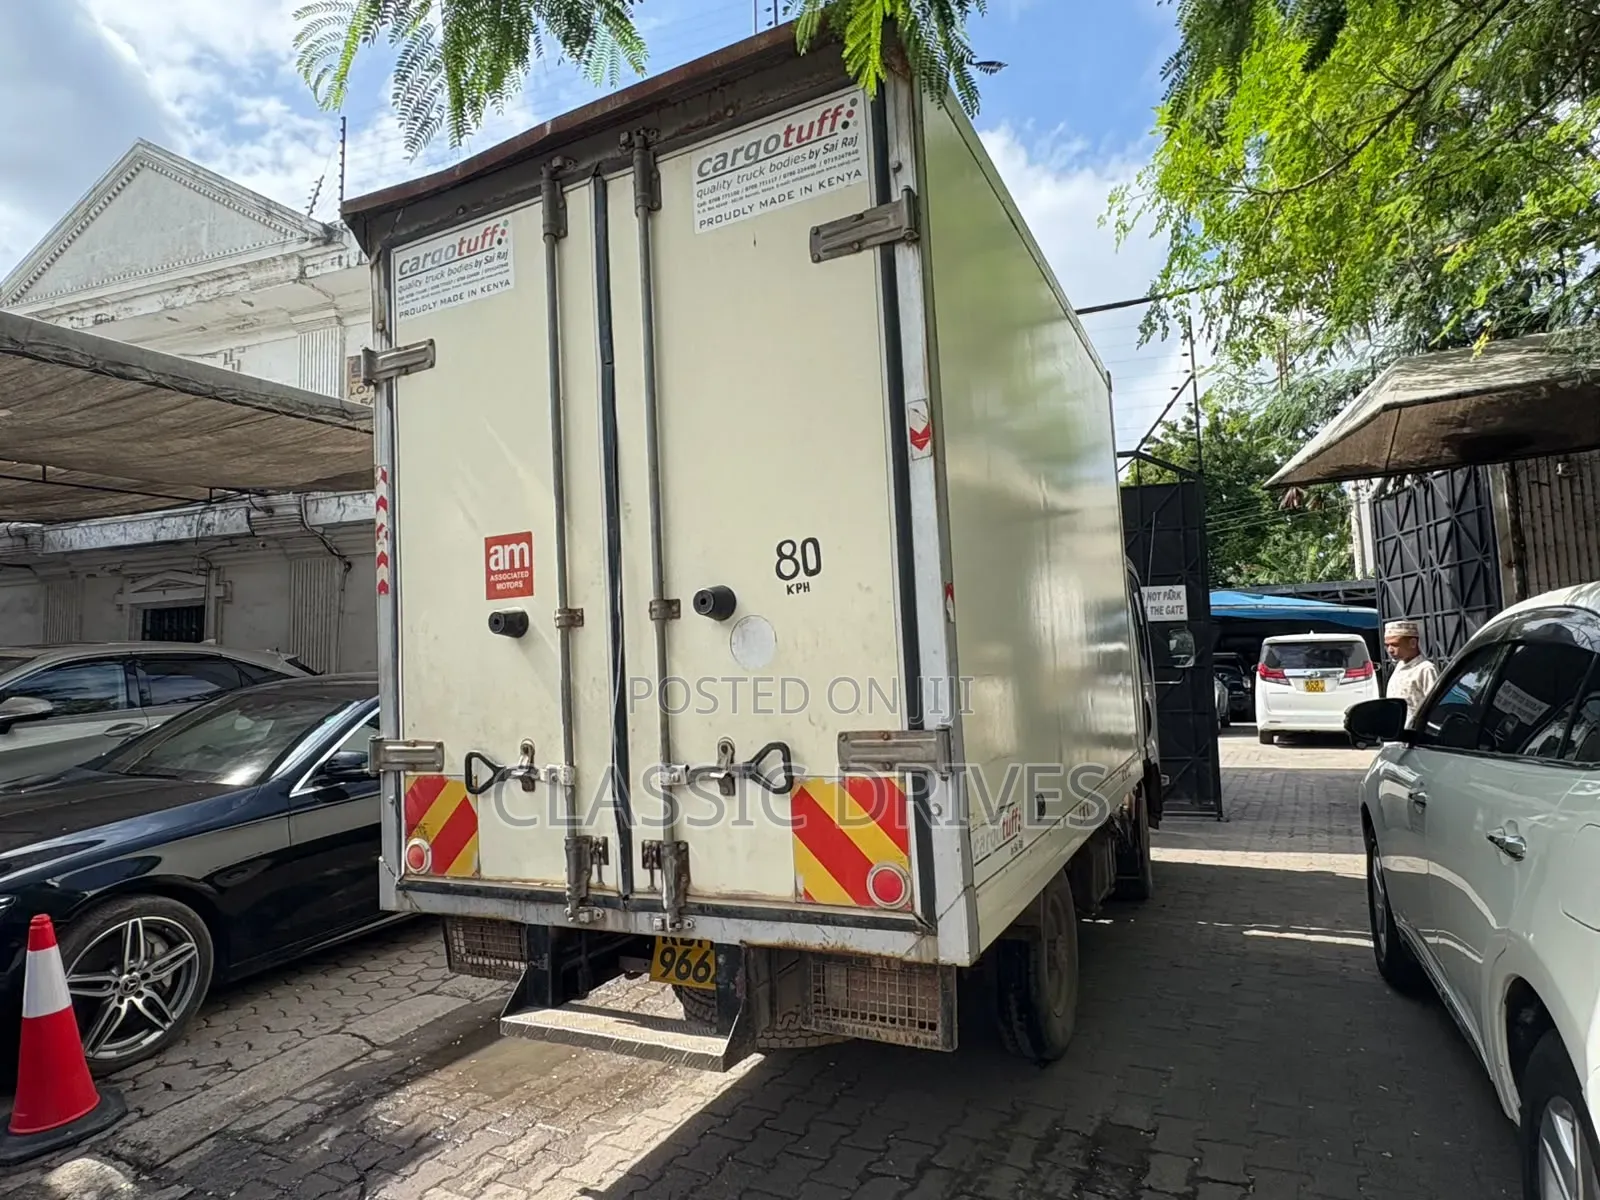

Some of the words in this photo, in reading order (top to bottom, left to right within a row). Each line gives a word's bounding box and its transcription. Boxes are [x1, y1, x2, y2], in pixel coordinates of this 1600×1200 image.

[697, 103, 845, 178] cargotuff
[696, 178, 733, 199] quality
[736, 165, 765, 183] truck
[769, 153, 807, 174] bodies
[808, 146, 820, 161] by
[822, 138, 838, 155] Sai
[841, 132, 859, 150] Raj
[698, 203, 755, 229] PROUDLY
[759, 191, 795, 209] MADE
[799, 182, 813, 196] IN
[818, 168, 862, 190] KENYA
[398, 223, 502, 277] cargotuff
[397, 278, 423, 294] quality
[425, 270, 446, 284] truck
[447, 262, 474, 277] bodies
[474, 257, 484, 268] by
[484, 252, 495, 265] Sai
[496, 248, 509, 261] Raj
[399, 300, 438, 319] PROUDLY
[440, 292, 465, 306] MADE
[468, 287, 477, 298] IN
[480, 278, 511, 293] KENYA
[489, 541, 530, 571] am
[775, 537, 822, 581] 80
[489, 570, 530, 582] ASSOCIATED
[496, 581, 523, 591] MOTORS
[786, 581, 811, 595] KPH
[1150, 606, 1164, 616] THE
[1165, 605, 1185, 615] GATE
[1163, 591, 1182, 601] PARK
[659, 946, 711, 984] 966
